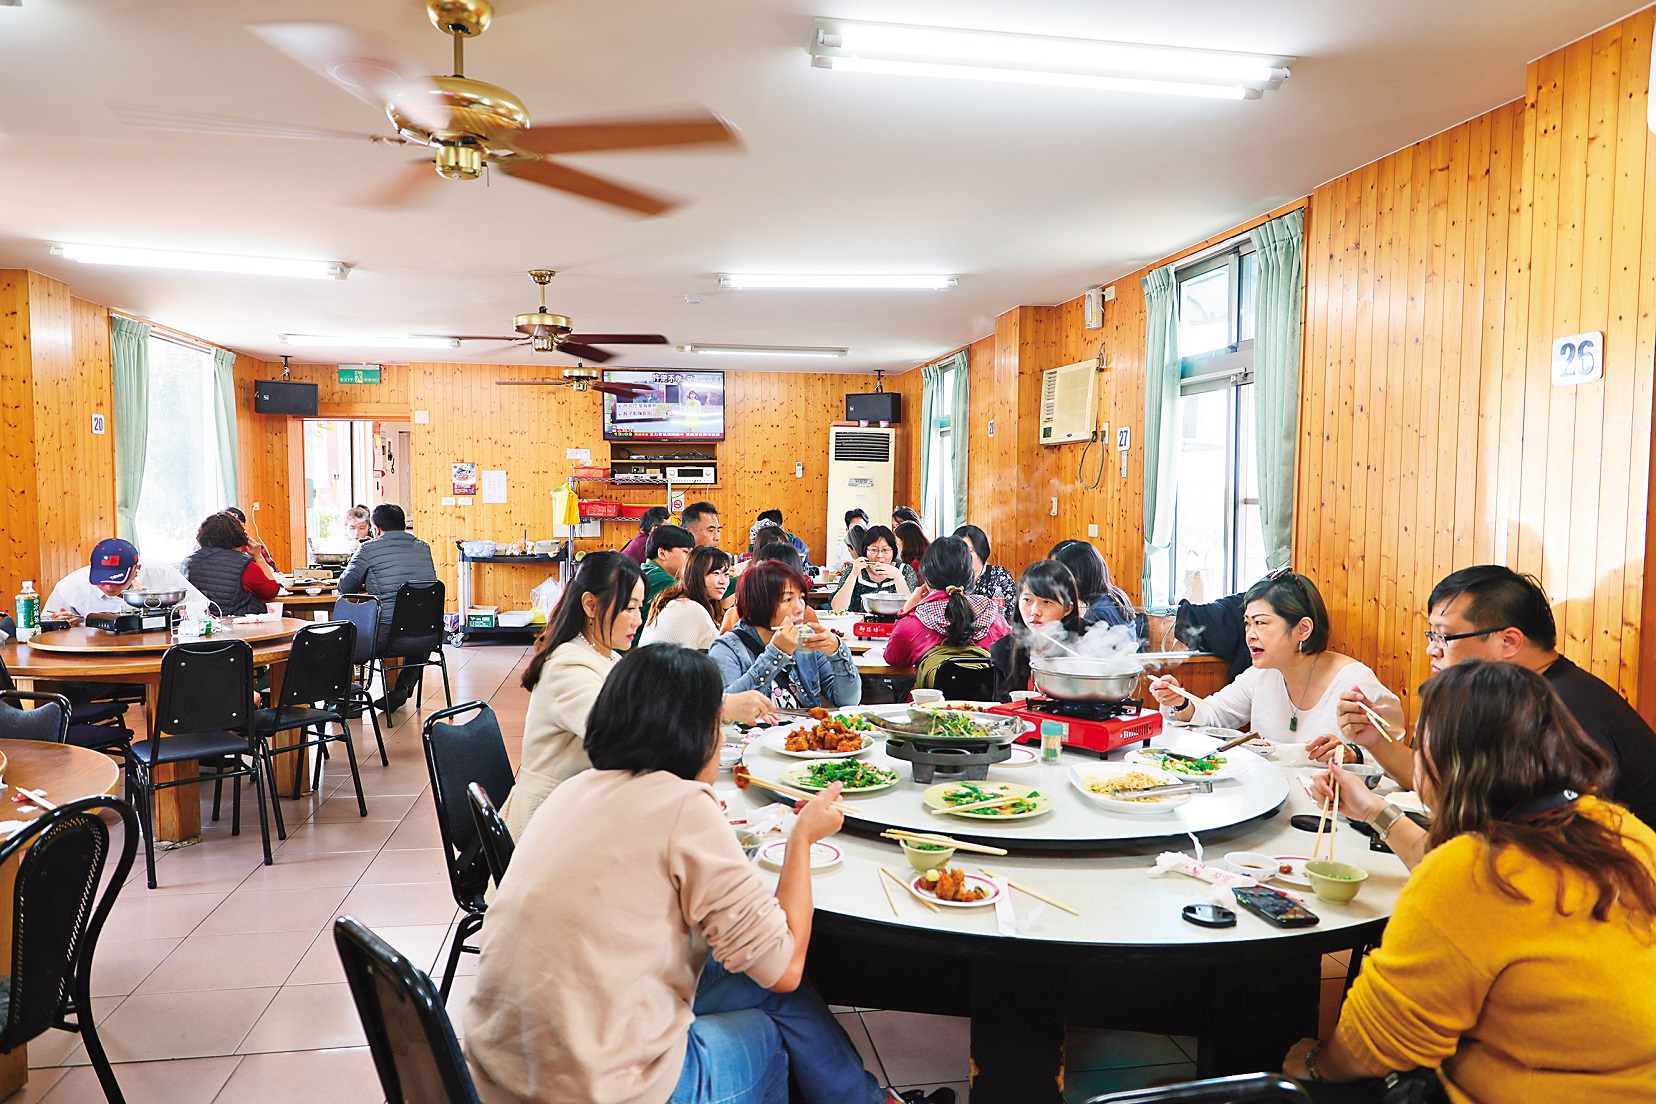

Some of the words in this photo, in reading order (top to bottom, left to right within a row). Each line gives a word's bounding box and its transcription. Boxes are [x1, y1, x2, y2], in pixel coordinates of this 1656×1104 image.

[1560, 339, 1595, 378] 26
[94, 416, 104, 431] 20
[1118, 429, 1129, 447] 27
